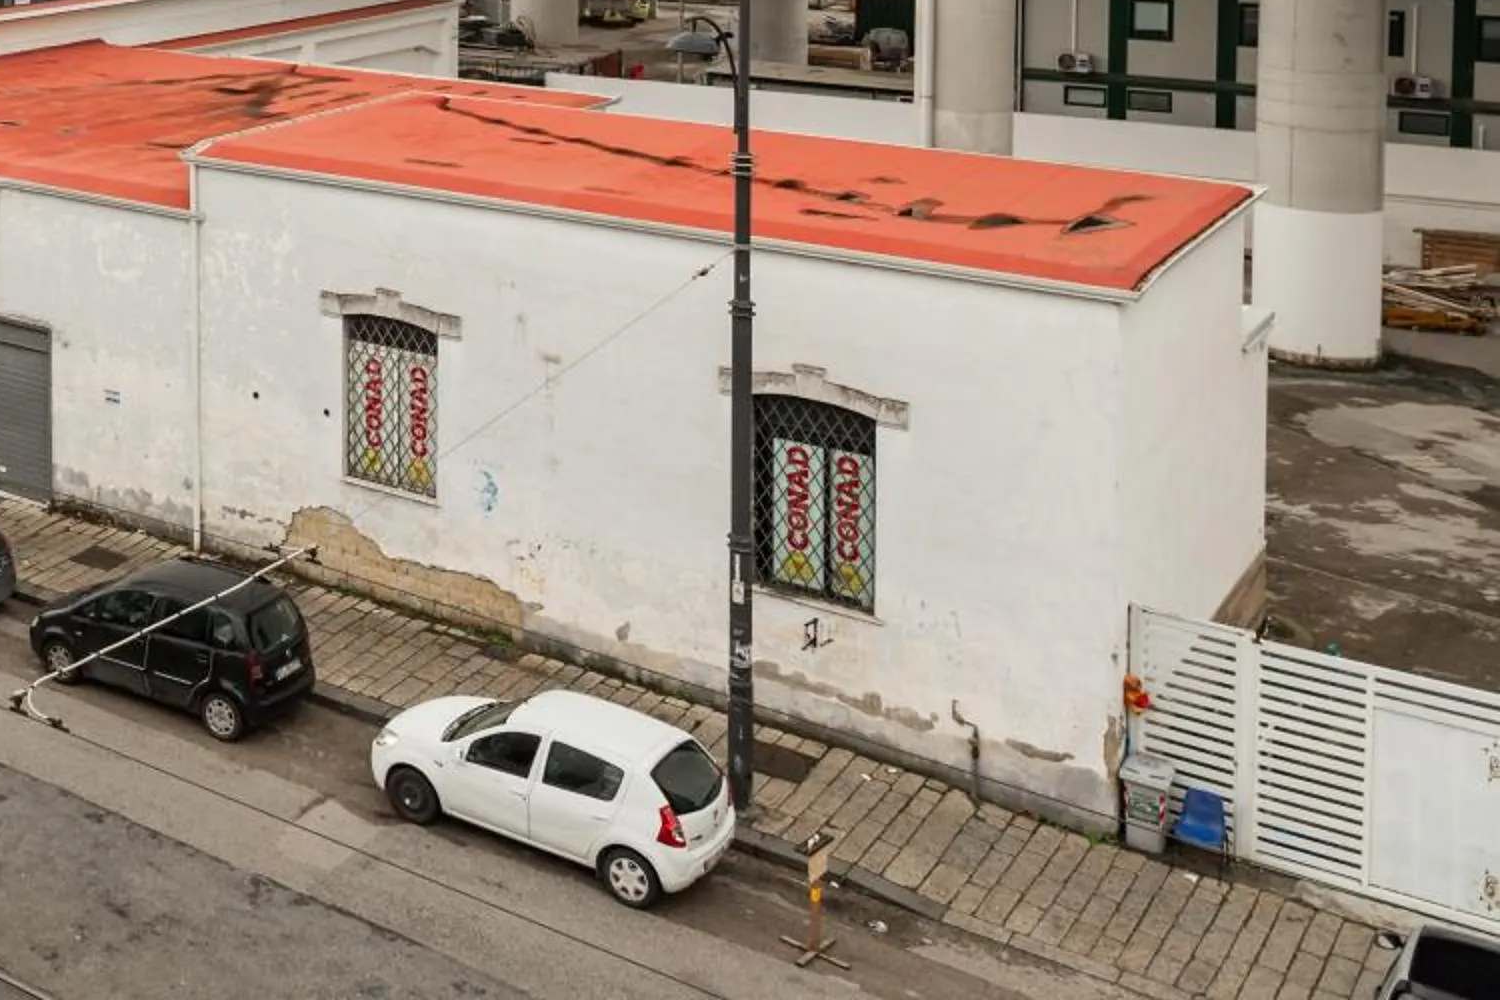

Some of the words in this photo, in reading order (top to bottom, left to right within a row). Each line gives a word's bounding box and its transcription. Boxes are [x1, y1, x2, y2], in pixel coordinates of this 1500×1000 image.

[365, 358, 382, 447] CONAD
[411, 367, 428, 457] CONAD
[787, 446, 809, 551] CONAD
[836, 456, 860, 562] CONAD
